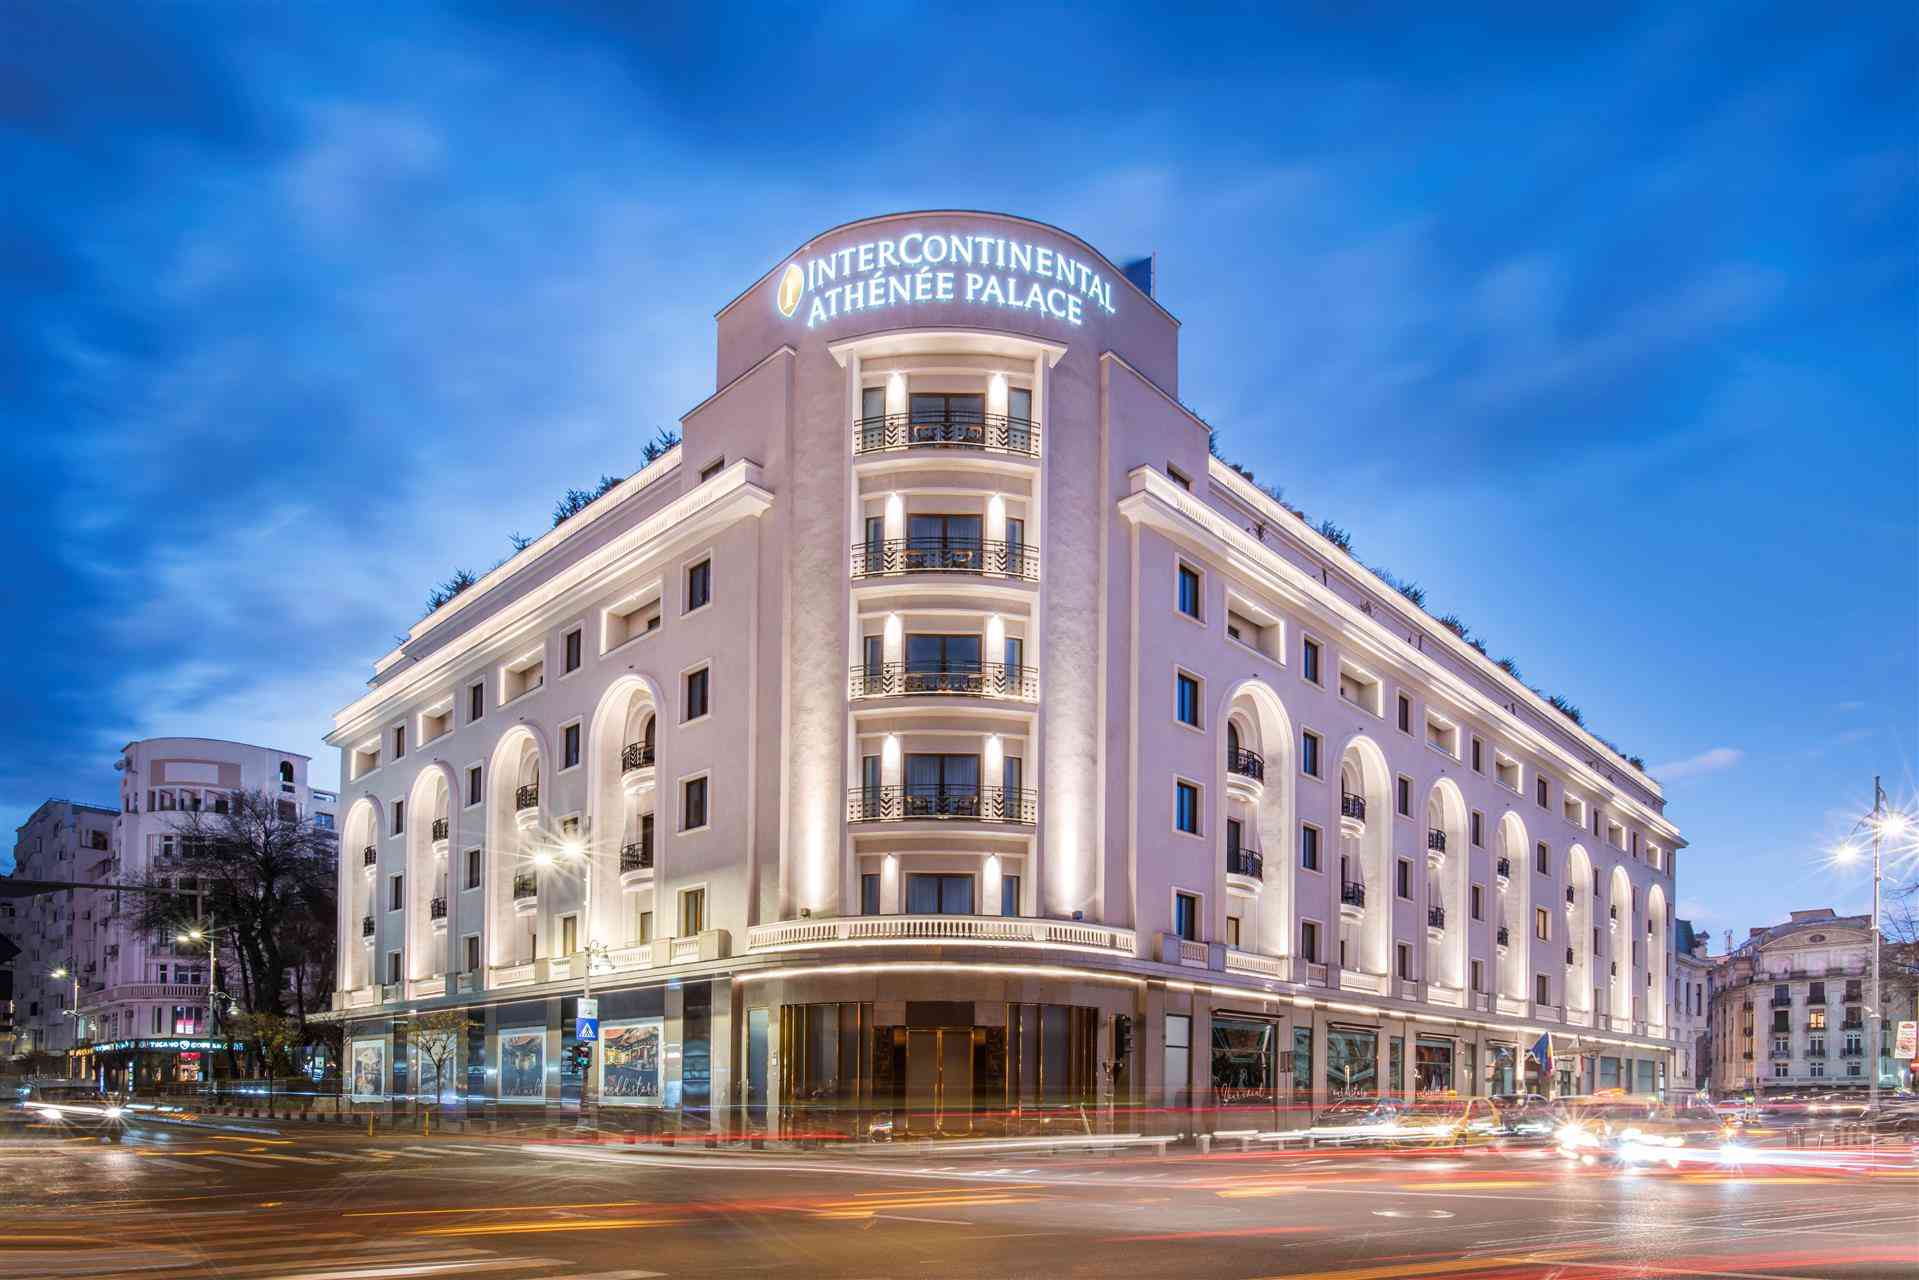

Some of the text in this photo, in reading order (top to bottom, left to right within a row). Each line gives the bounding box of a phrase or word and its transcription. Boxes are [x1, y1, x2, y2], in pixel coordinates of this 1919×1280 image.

[807, 266, 1082, 328] ATHÉNÉE PALACE
[808, 233, 1115, 313] INTERCONTINENTAL
